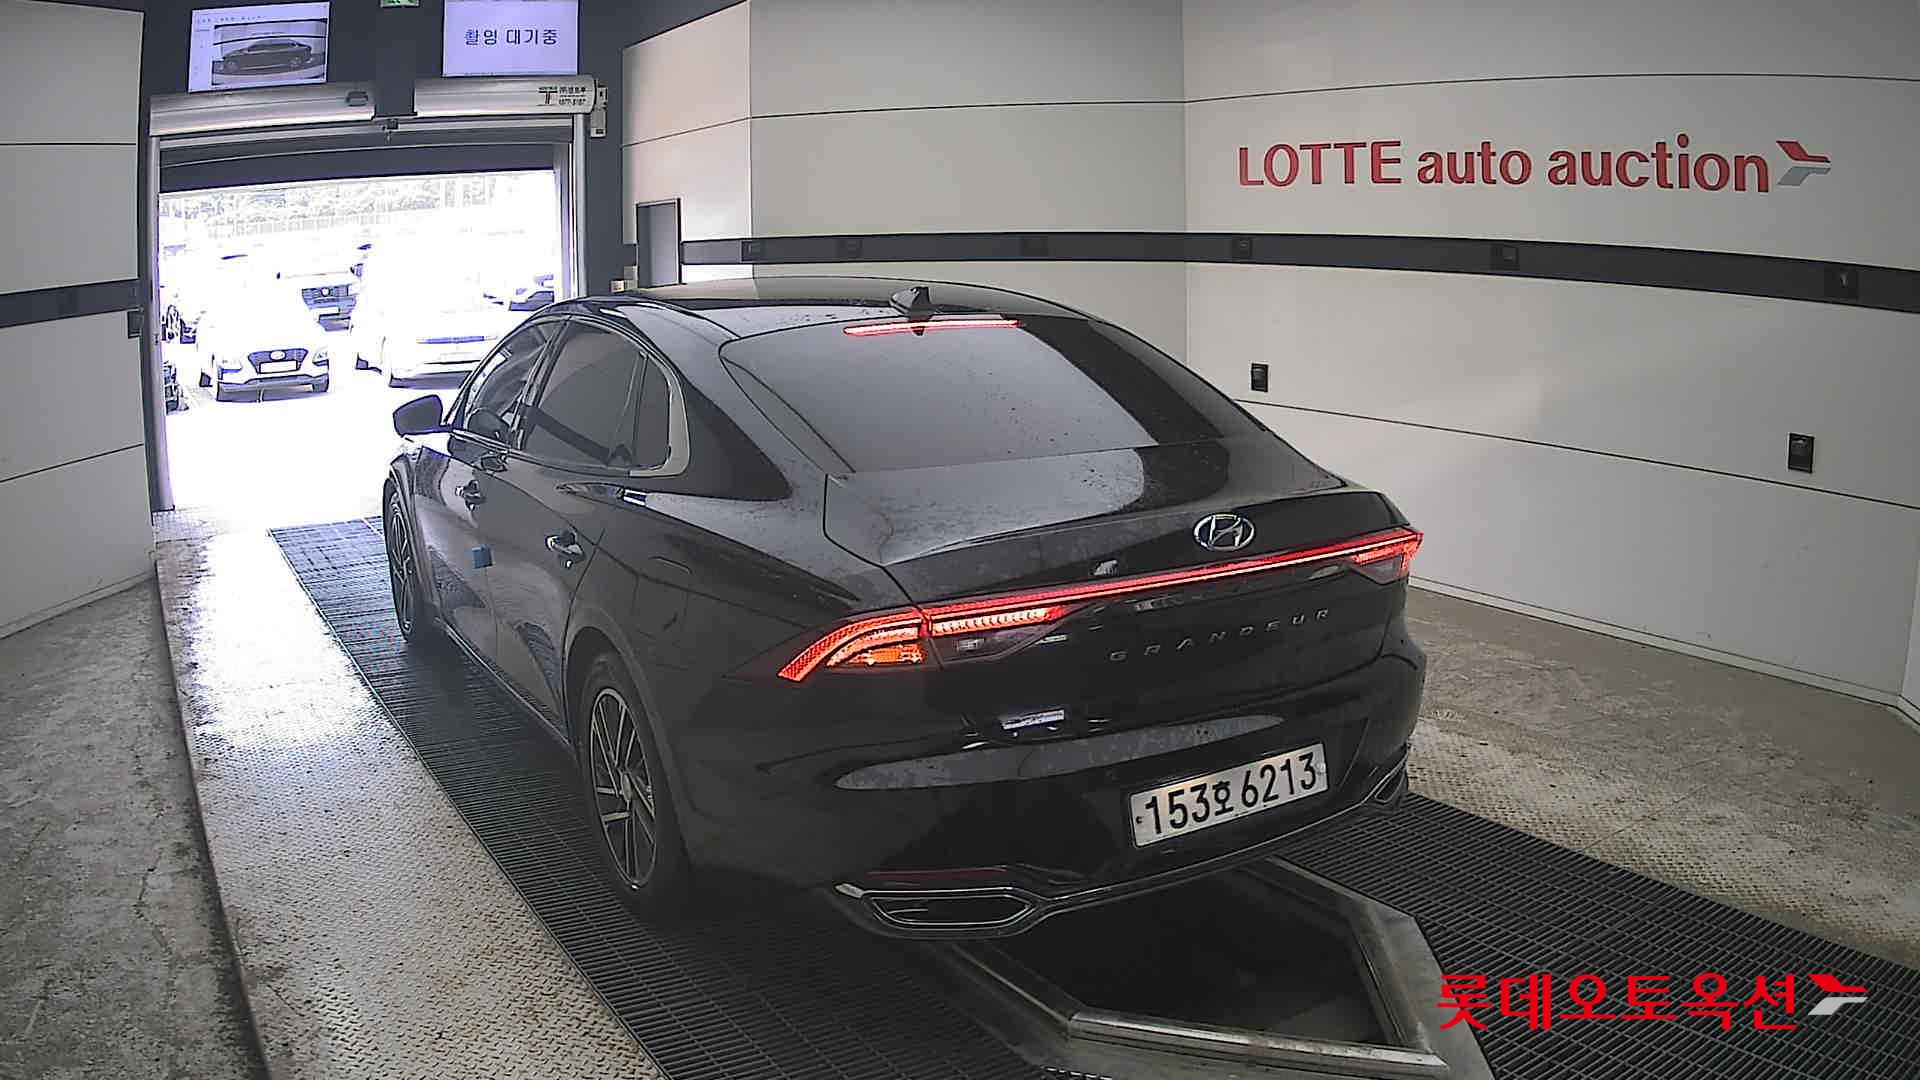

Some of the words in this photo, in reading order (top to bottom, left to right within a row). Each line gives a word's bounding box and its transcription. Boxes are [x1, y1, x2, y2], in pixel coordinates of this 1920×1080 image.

[505, 28, 558, 46] 대기중
[1238, 140, 1402, 187] LOTTE
[1416, 140, 1533, 187] auto
[1547, 133, 1770, 193] auction
[1109, 608, 1330, 662] GRANDEUR
[1144, 780, 1235, 835] 153호
[1240, 751, 1317, 808] 6213
